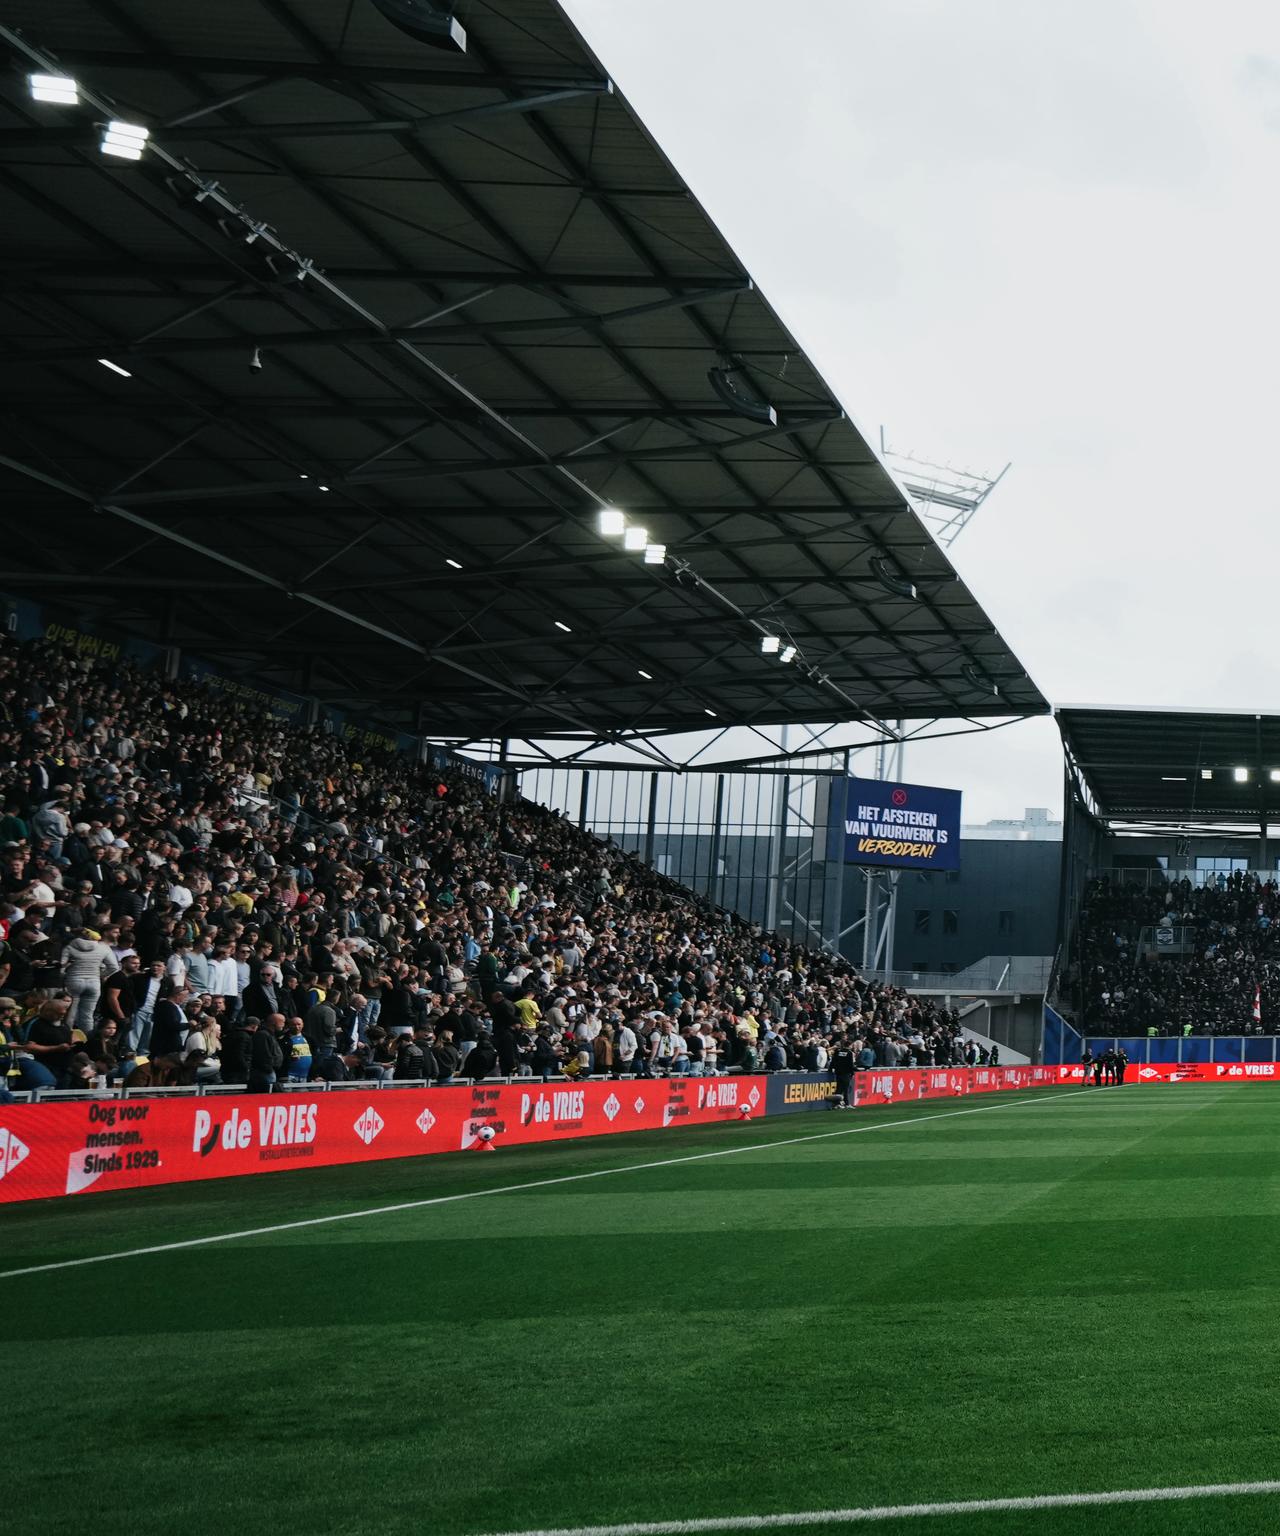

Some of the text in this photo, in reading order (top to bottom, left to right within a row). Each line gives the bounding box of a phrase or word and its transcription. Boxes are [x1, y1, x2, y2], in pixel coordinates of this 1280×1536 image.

[858, 806, 937, 827] HET AFSTEKEN
[845, 820, 948, 843] VAN VUURWERK IS
[857, 839, 936, 858] VERBODEN!
[1229, 1065, 1243, 1076] de
[1245, 1064, 1274, 1075] VRIES
[535, 1092, 550, 1123] de
[553, 1090, 585, 1121] VRIES
[706, 1084, 716, 1107] de
[718, 1083, 738, 1106] VRIES
[89, 1103, 149, 1126] Oog voor
[222, 1108, 252, 1150] de
[259, 1104, 318, 1146] VRIES
[86, 1129, 143, 1149] mensen.
[83, 1150, 162, 1174] Sinds 1929.
